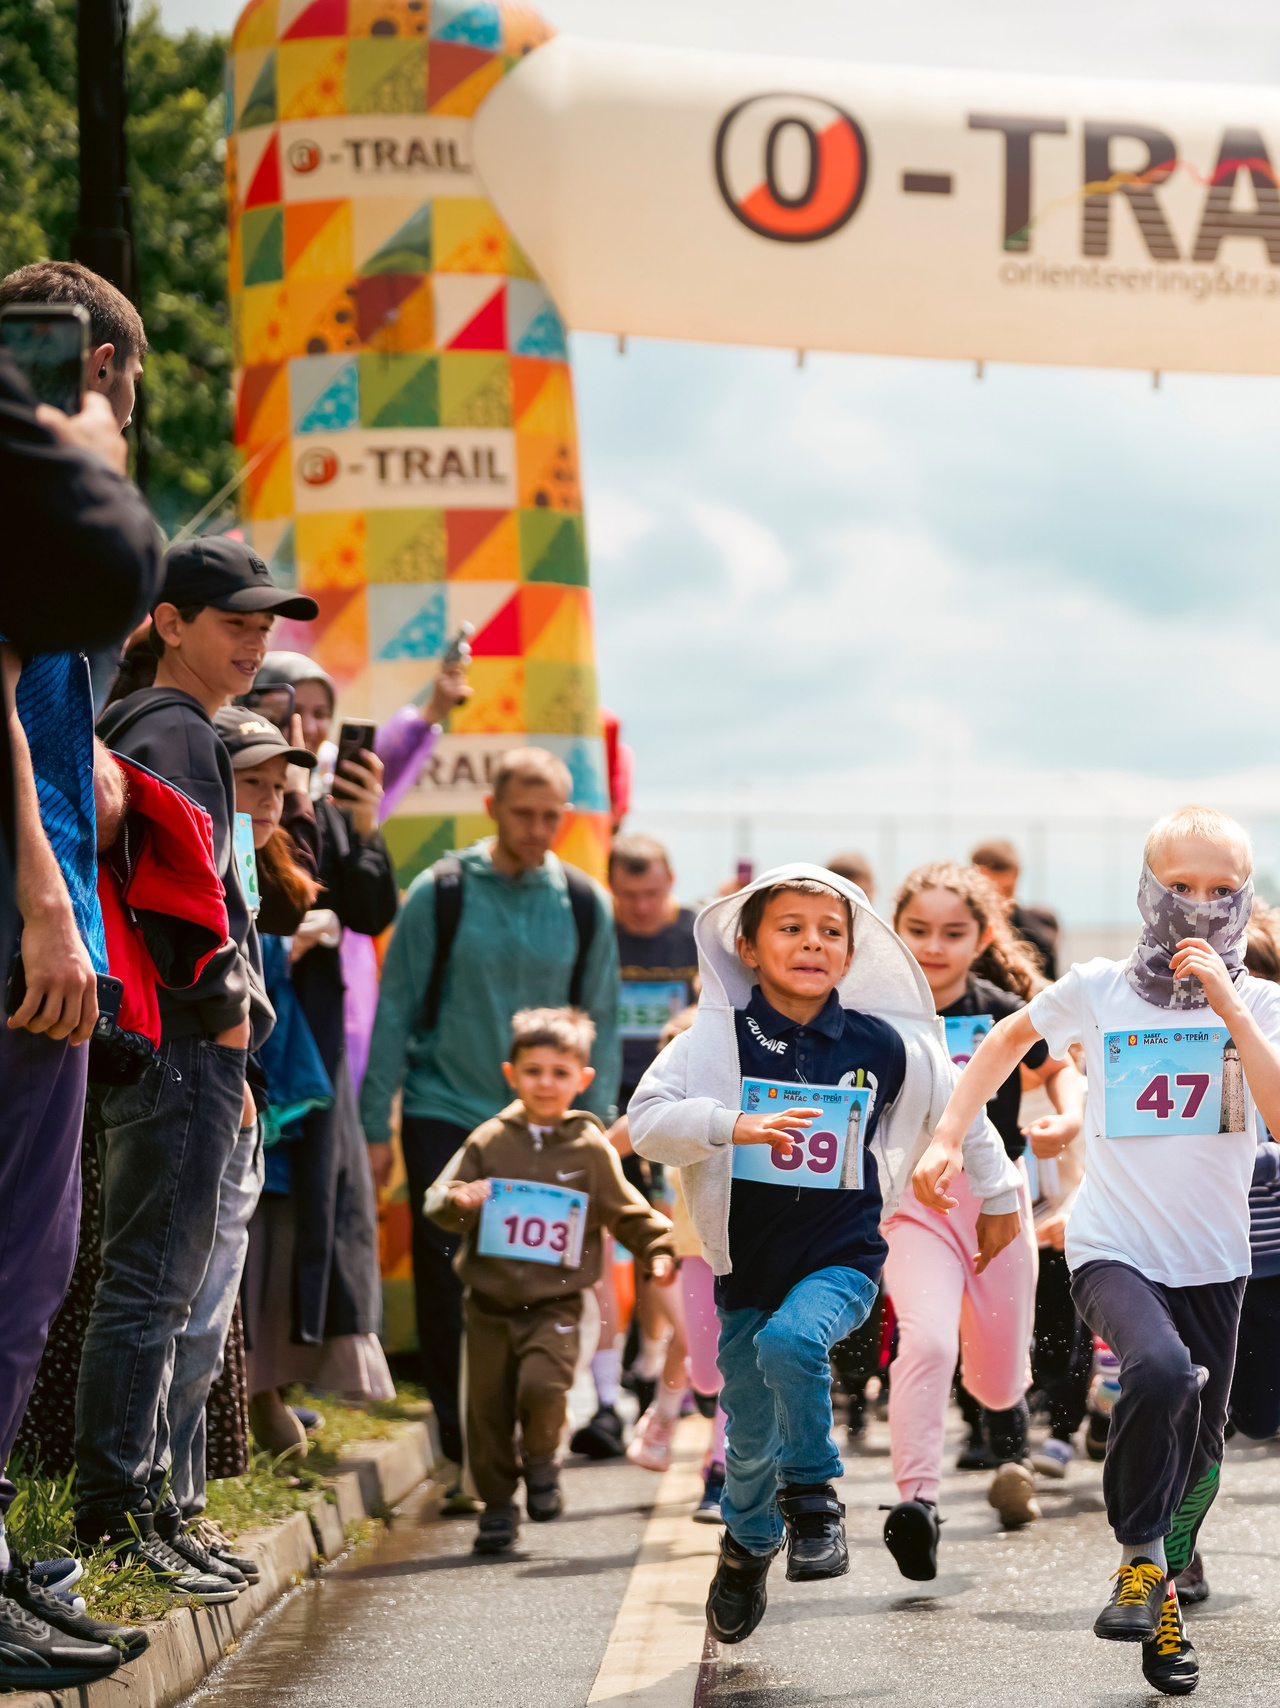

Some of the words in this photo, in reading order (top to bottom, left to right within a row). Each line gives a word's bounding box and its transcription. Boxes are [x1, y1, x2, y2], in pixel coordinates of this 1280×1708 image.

[1143, 1037, 1168, 1045] МАГАС
[783, 1094, 808, 1102] МАГАС
[1135, 1073, 1211, 1119] 47
[770, 1128, 838, 1174] 69
[503, 1214, 570, 1252] 103
